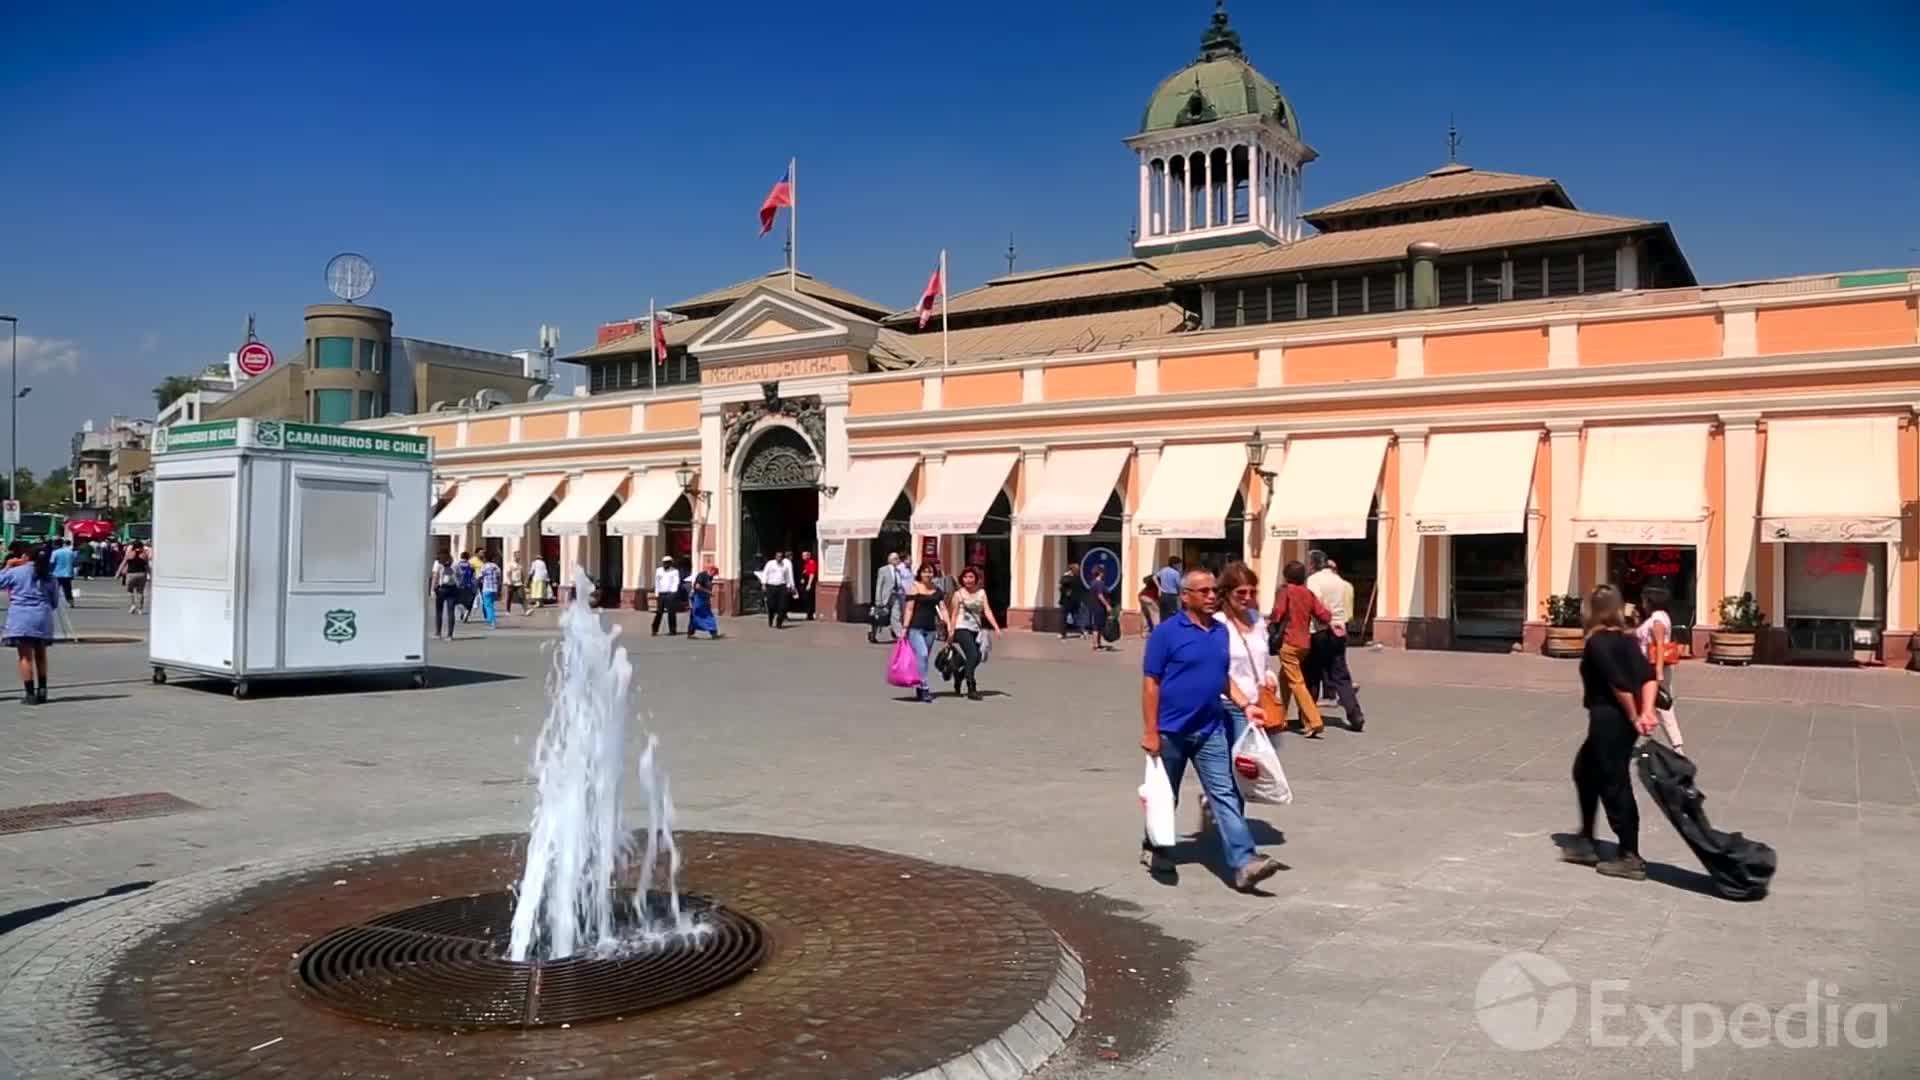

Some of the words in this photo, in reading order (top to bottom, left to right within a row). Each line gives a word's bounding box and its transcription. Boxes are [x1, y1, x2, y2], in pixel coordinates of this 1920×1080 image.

[286, 430, 372, 449] CARABINEROS
[375, 437, 390, 450] DE
[393, 441, 427, 454] CHILE
